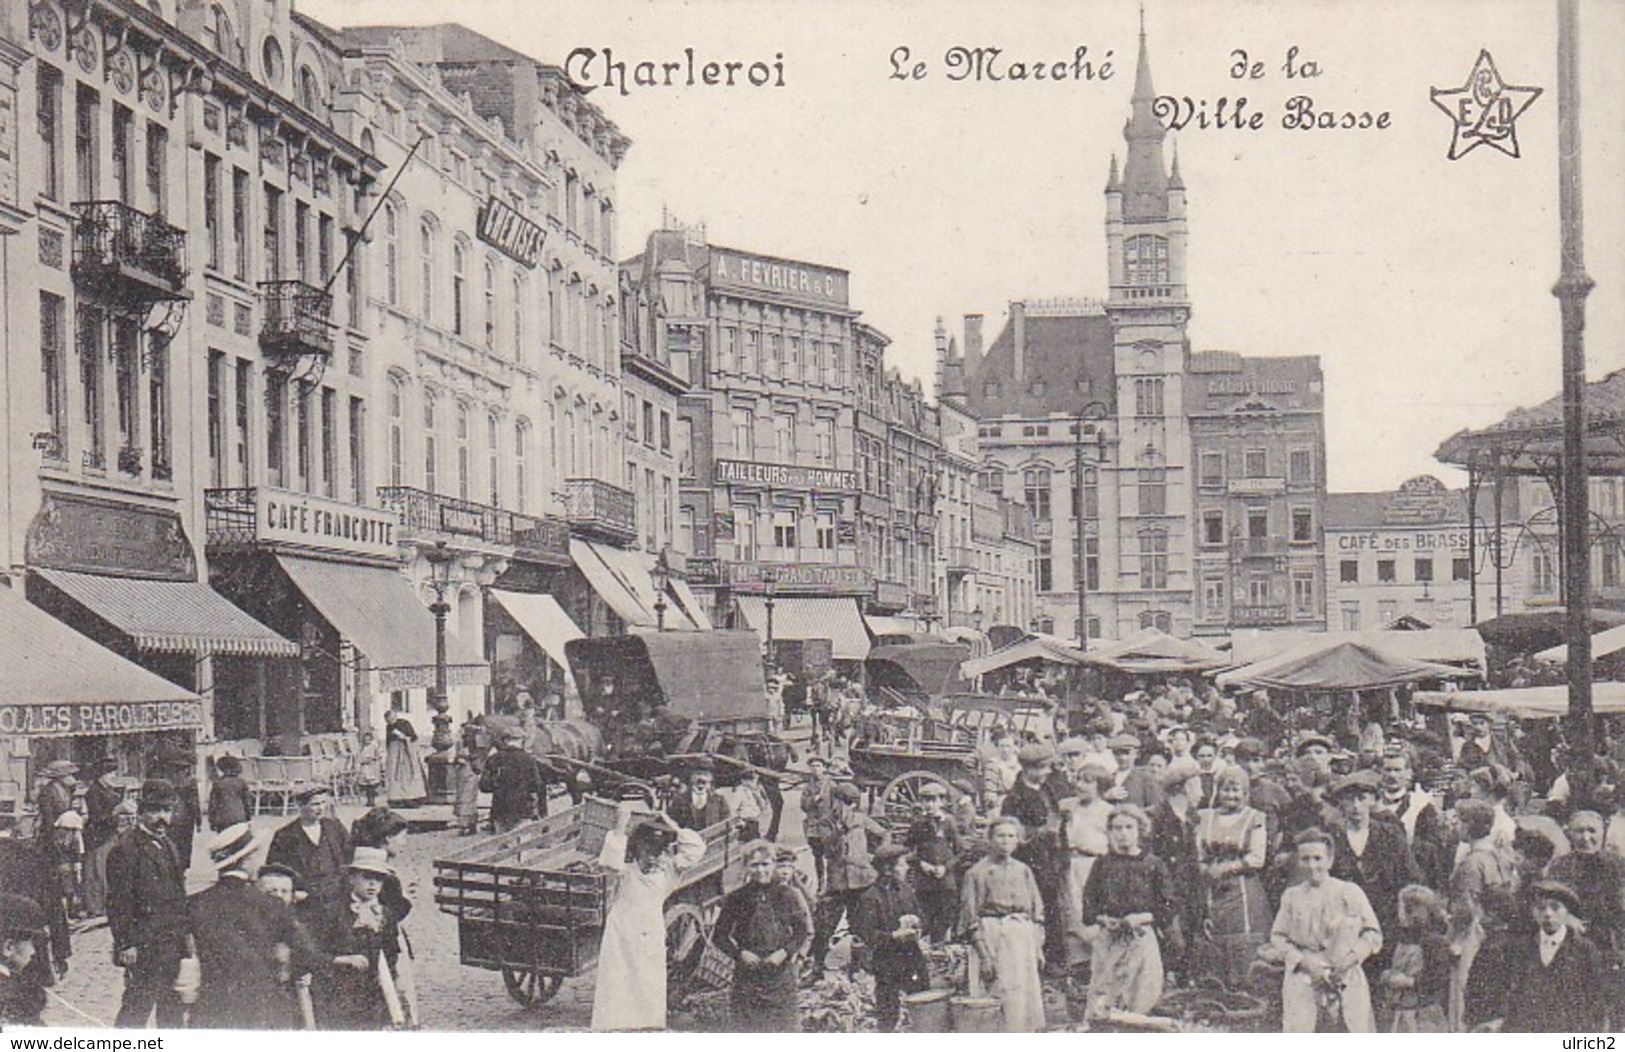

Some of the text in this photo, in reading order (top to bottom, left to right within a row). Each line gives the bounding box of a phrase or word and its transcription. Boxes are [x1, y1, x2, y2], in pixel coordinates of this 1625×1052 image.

[741, 259, 810, 292] FEVRIER
[719, 462, 788, 483] TAILLEURS
[808, 470, 856, 488] HOMMES
[267, 500, 309, 533] CAFÉ
[1339, 532, 1507, 550] CAFÉ DES BRASSURS
